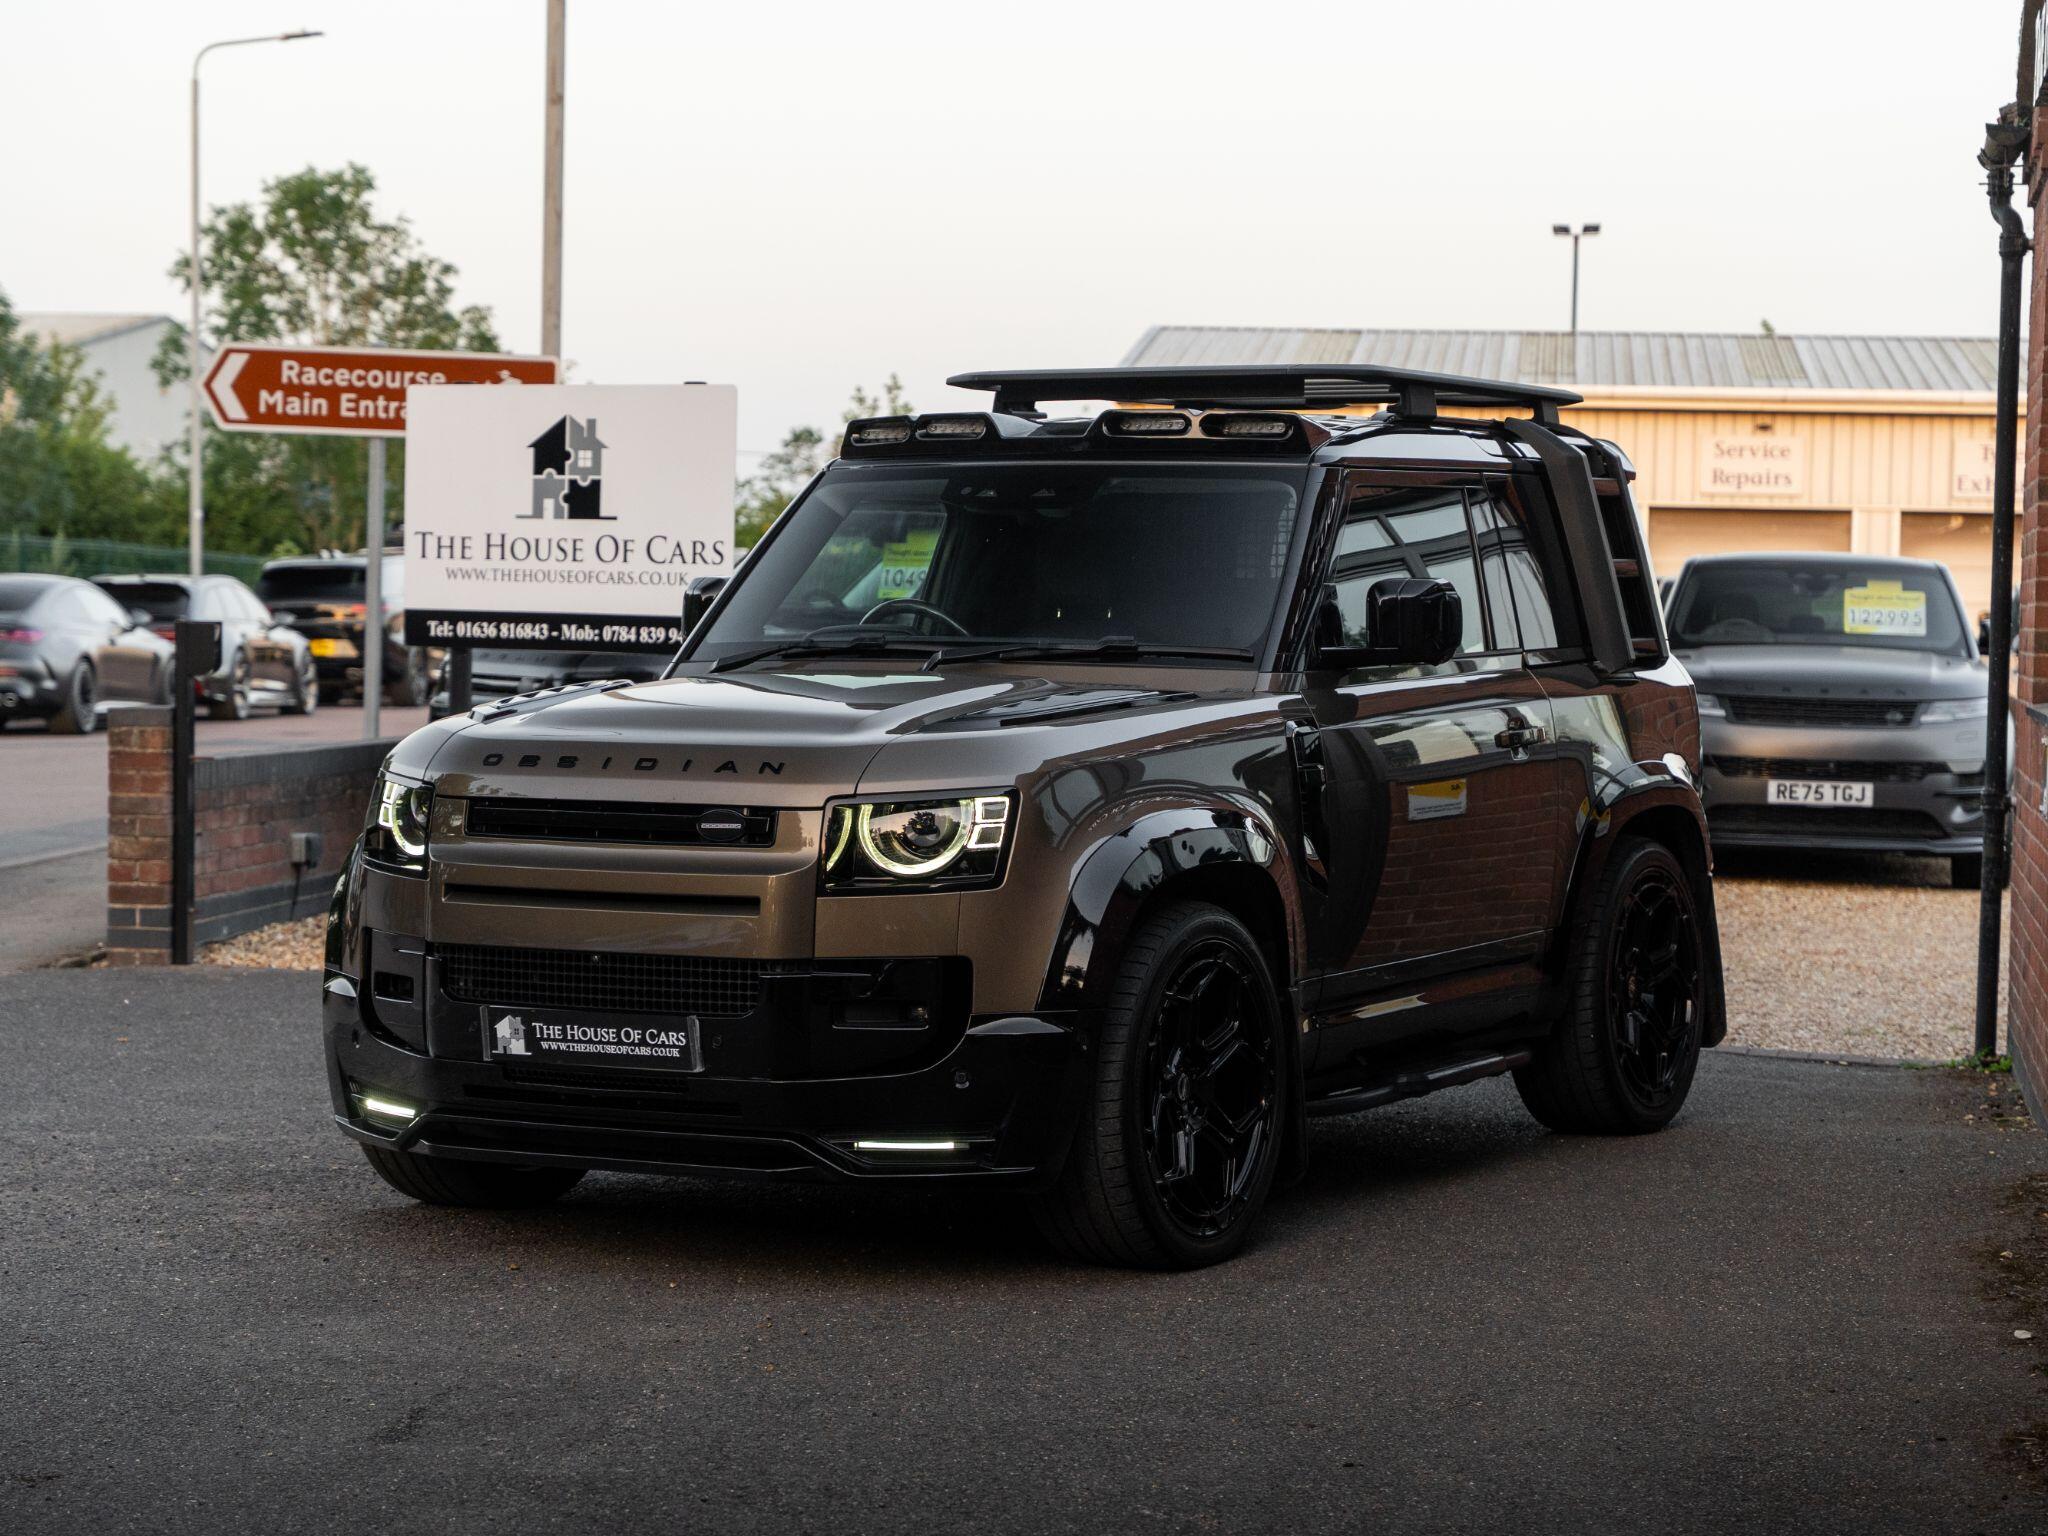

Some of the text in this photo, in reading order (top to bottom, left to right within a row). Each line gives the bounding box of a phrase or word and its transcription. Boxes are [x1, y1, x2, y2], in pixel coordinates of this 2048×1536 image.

[281, 359, 446, 388] Racecourse
[258, 389, 329, 416] Main
[1713, 440, 1791, 460] Service
[1712, 467, 1792, 490] Repairs
[414, 531, 725, 566] THE HOUSE OF CARS
[445, 567, 689, 586] WWW.THEHOUSEOFCARS.CO.UK
[1849, 608, 1922, 626] 122995
[427, 620, 454, 637] Tel:
[456, 621, 497, 639] 01636
[499, 622, 549, 641] 816843
[561, 623, 600, 641] Mob:
[602, 625, 637, 642] 0784
[639, 626, 667, 644] 839
[483, 753, 785, 775] OBSIDIAN
[1776, 783, 1867, 803] RE75 TGJ
[531, 1022, 686, 1046] THE HOUSE OF CARS
